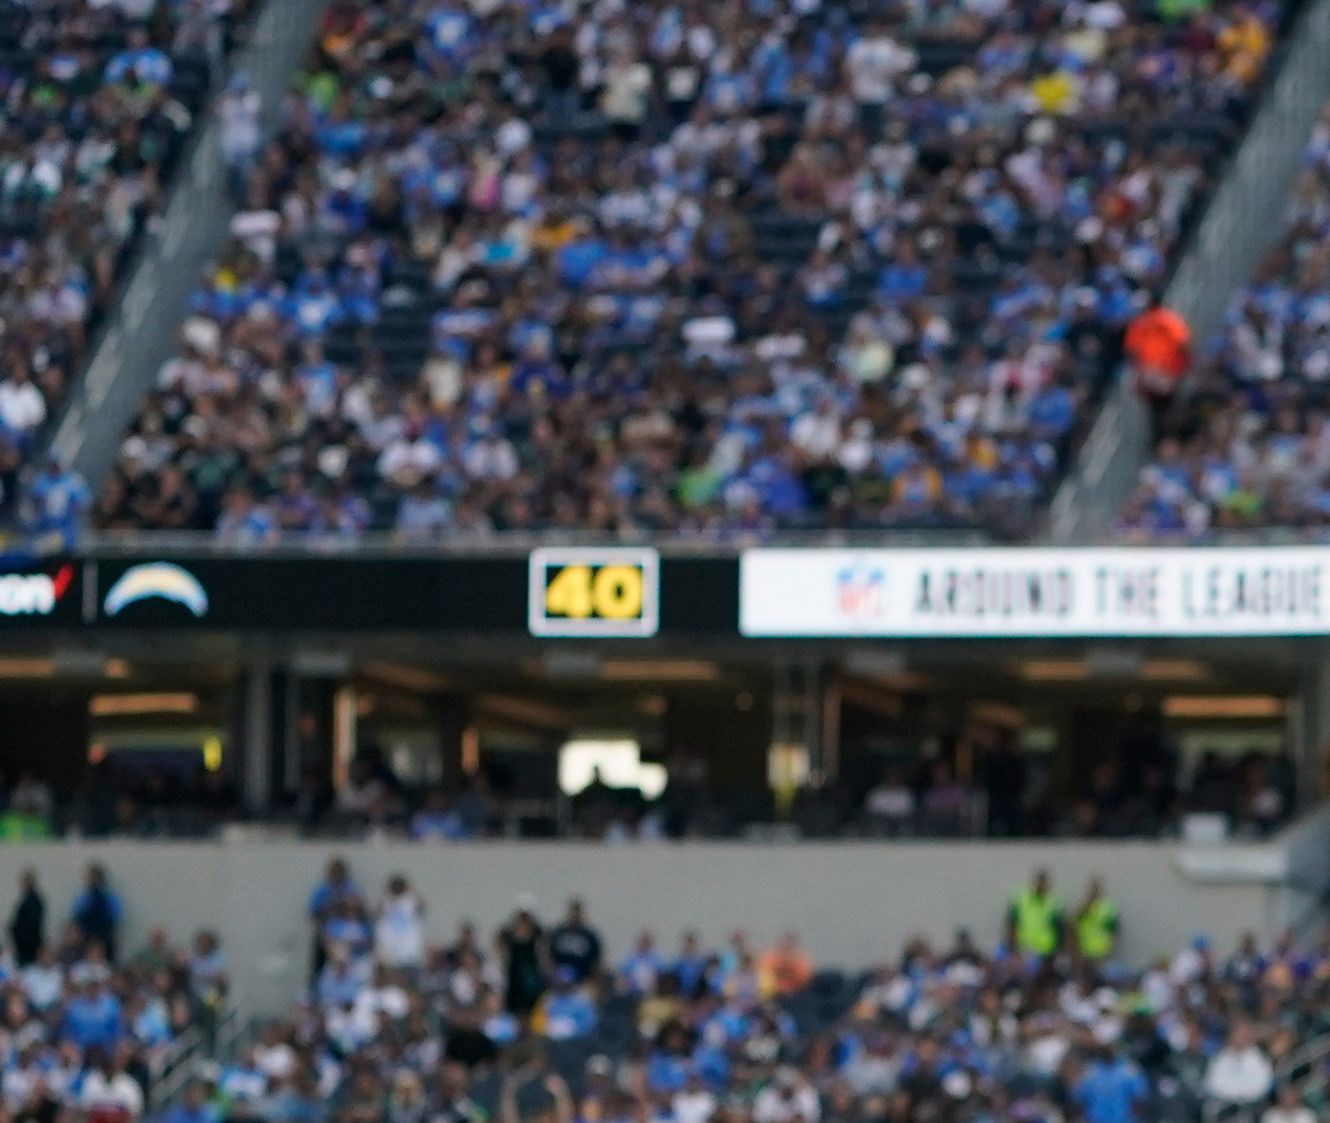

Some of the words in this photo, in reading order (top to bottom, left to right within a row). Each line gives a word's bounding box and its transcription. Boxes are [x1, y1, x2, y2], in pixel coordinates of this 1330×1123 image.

[545, 564, 643, 620] 40
[915, 567, 1072, 616] AROUND
[1094, 565, 1161, 618] THE
[1181, 563, 1322, 618] LEAGUE
